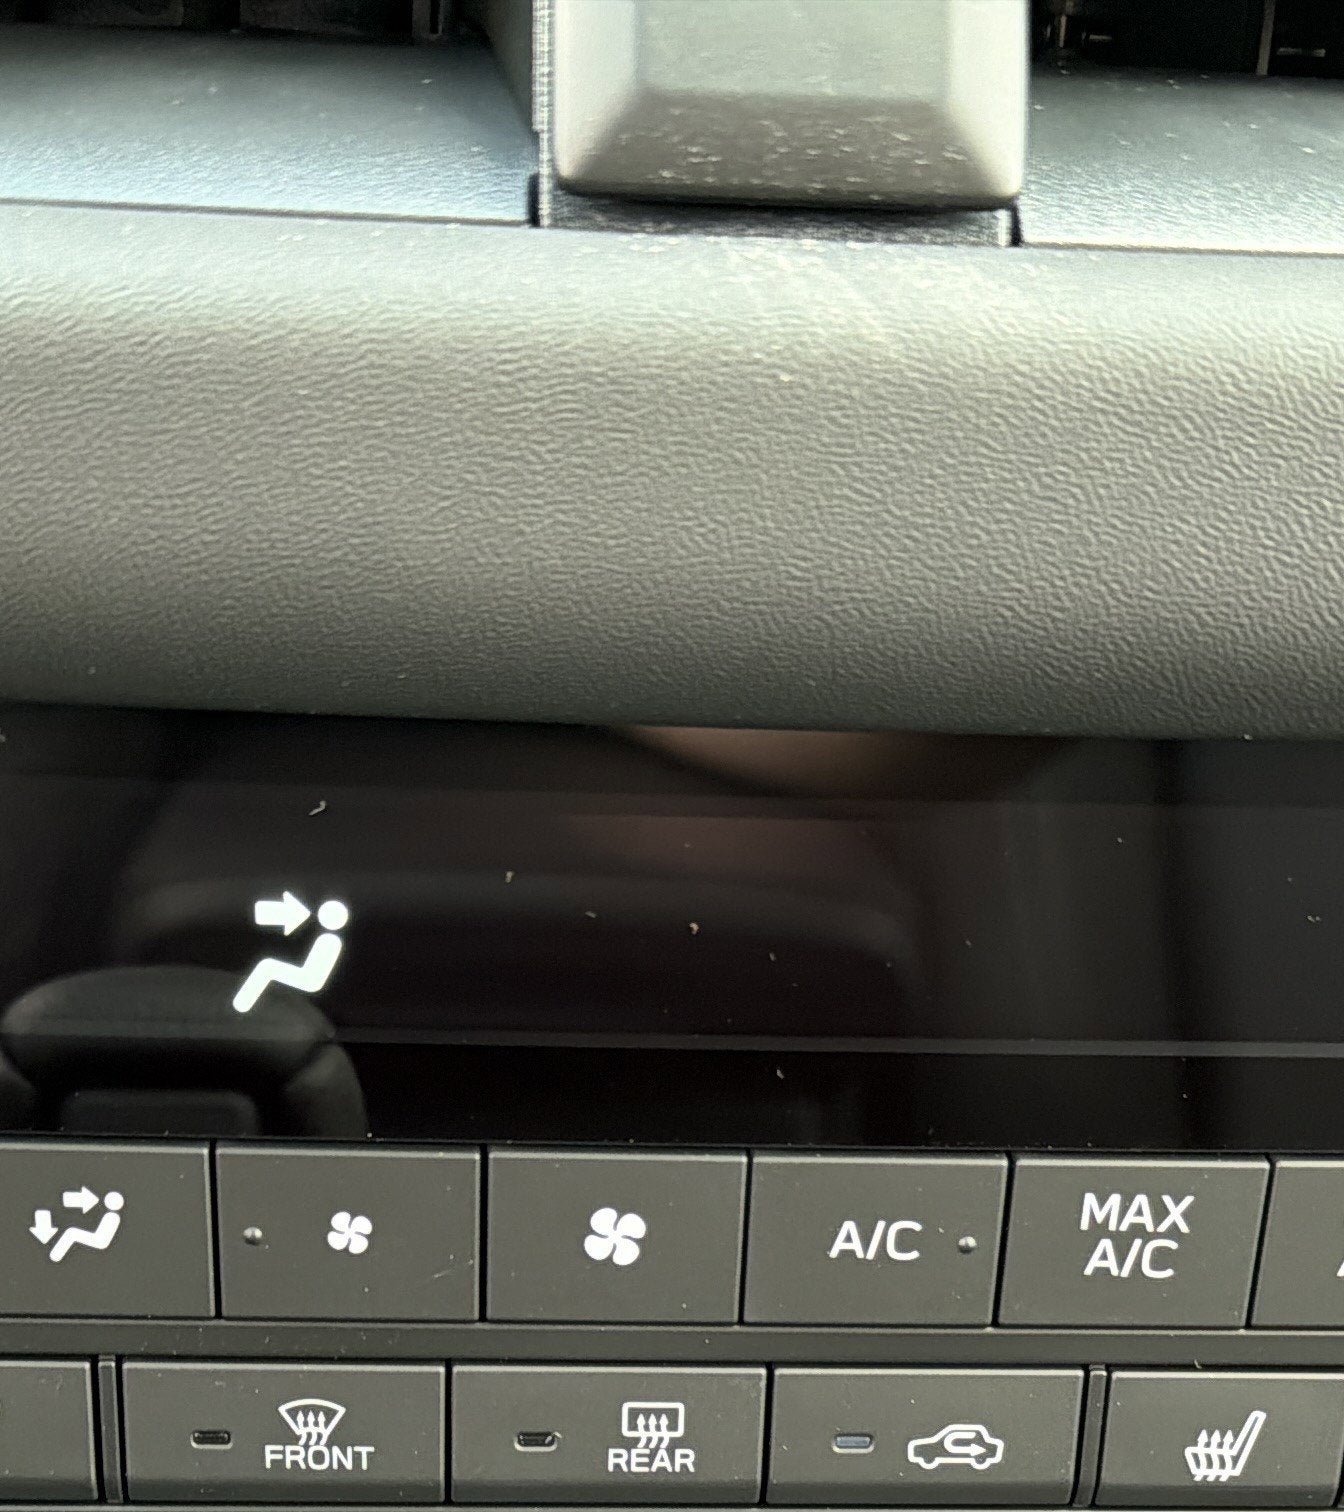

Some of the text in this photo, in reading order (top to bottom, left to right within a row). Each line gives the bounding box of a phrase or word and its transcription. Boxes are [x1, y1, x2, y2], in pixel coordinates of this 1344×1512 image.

[1079, 1191, 1197, 1234] MAX
[827, 1218, 924, 1262] A/C
[1083, 1238, 1179, 1280] A/C
[264, 1443, 375, 1471] FRONT
[607, 1446, 697, 1473] REAR
